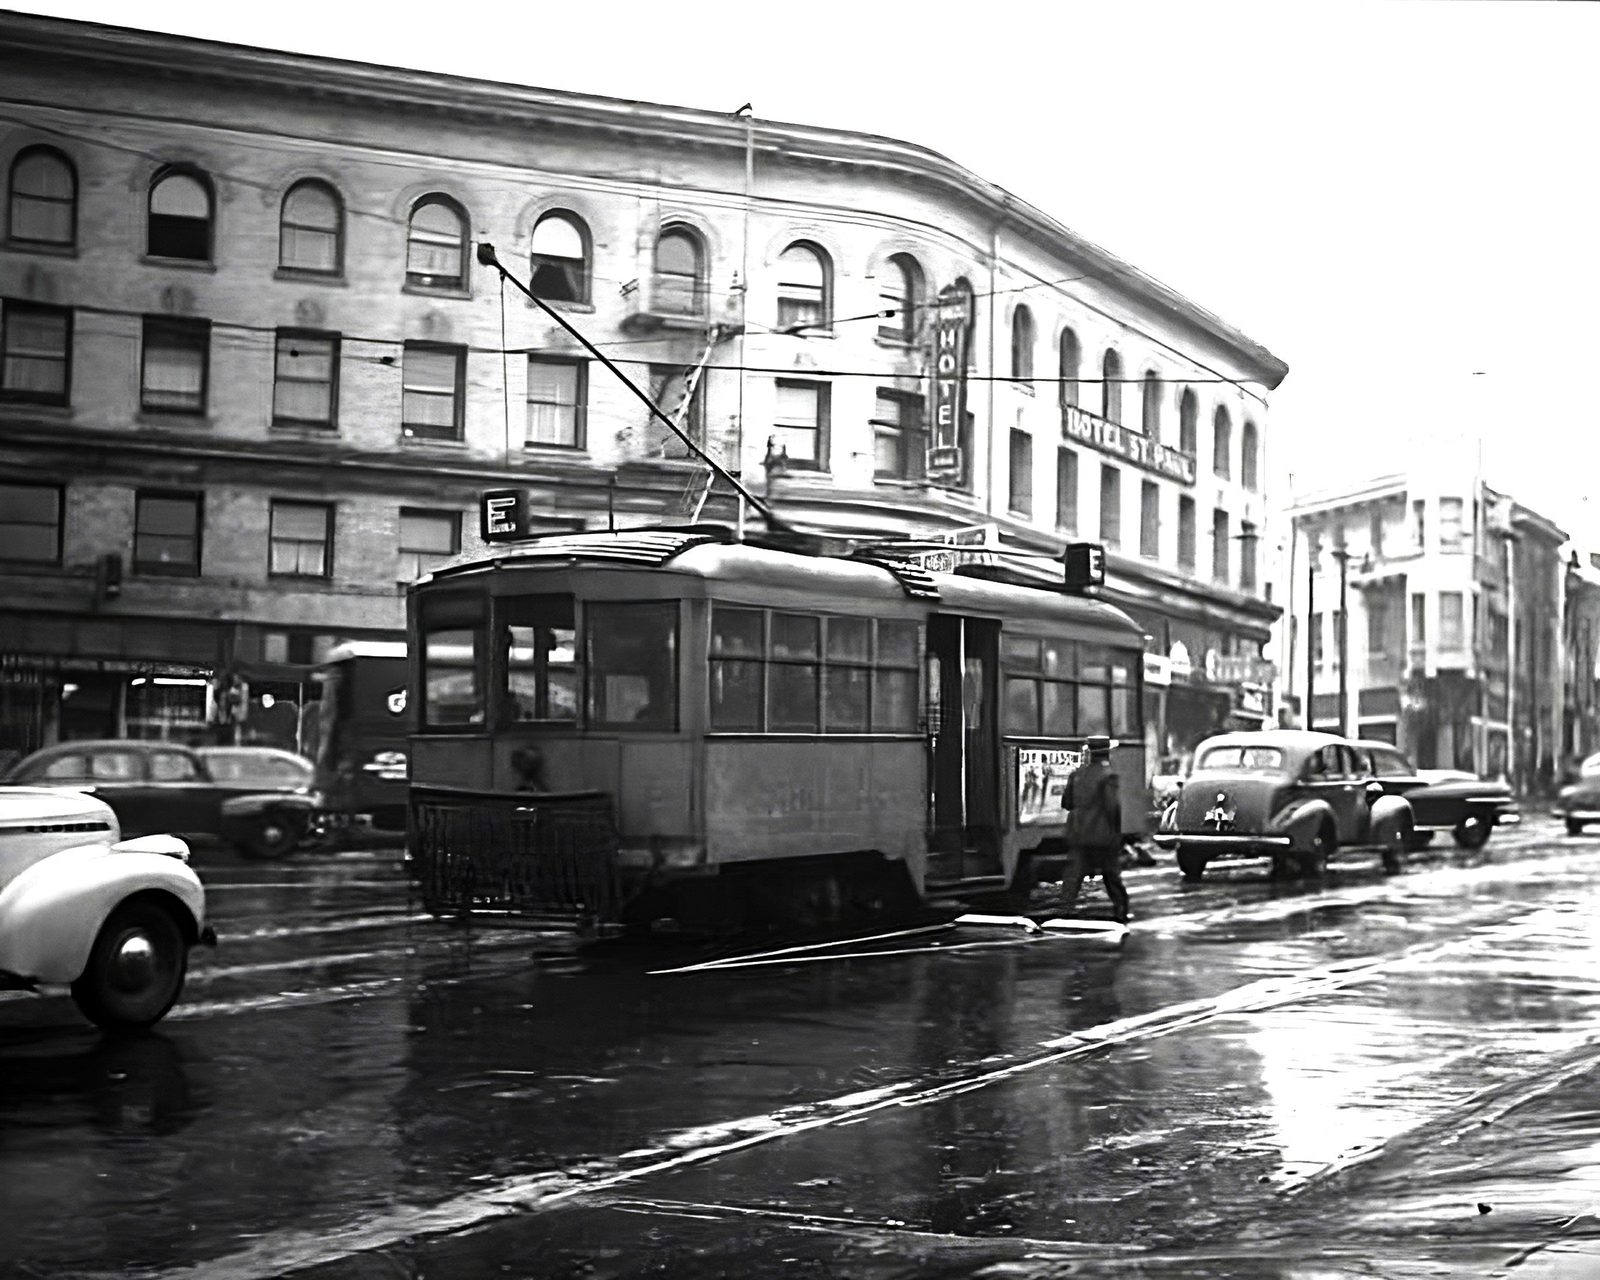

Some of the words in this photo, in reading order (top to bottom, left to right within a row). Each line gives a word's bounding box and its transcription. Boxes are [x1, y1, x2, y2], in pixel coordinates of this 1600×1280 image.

[938, 328, 956, 449] HOTEL
[1066, 408, 1125, 453] HOTEL
[487, 497, 516, 534] E
[1089, 548, 1102, 578] E
